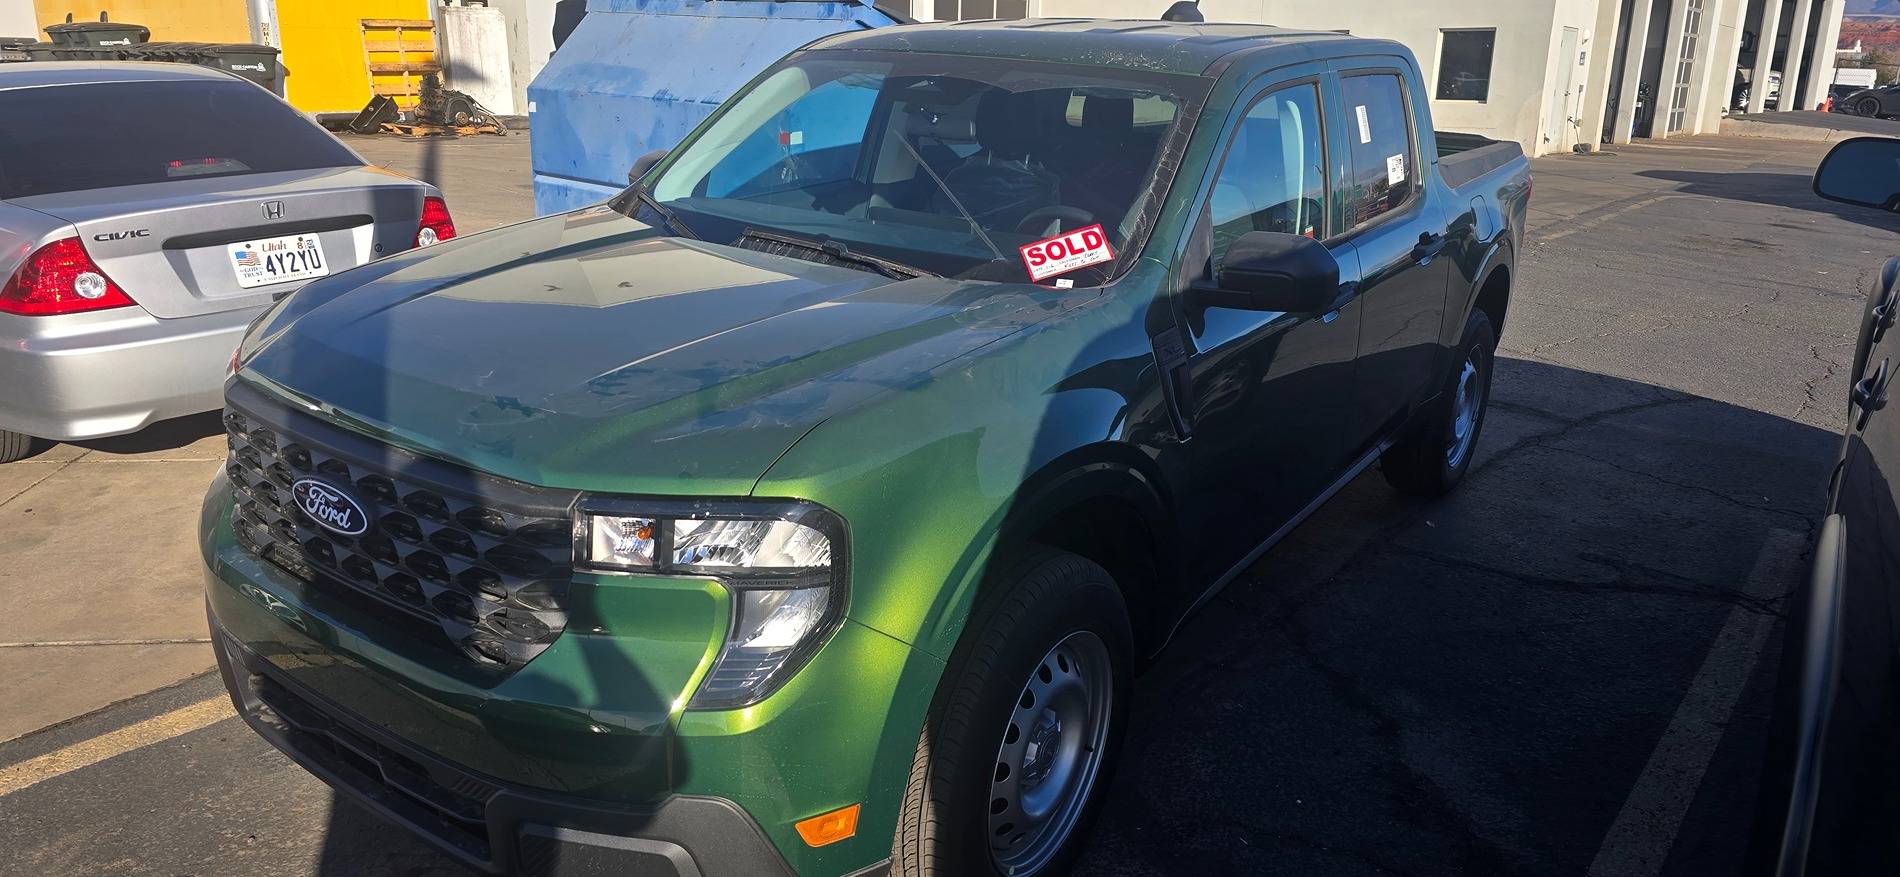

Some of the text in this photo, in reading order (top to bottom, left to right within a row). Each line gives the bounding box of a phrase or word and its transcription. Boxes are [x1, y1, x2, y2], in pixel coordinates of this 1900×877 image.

[93, 229, 150, 241] CIVIC
[262, 240, 287, 252] Utah
[1027, 230, 1103, 267] SOLD
[266, 248, 322, 276] 4Y2YU
[306, 486, 351, 528] Ford
